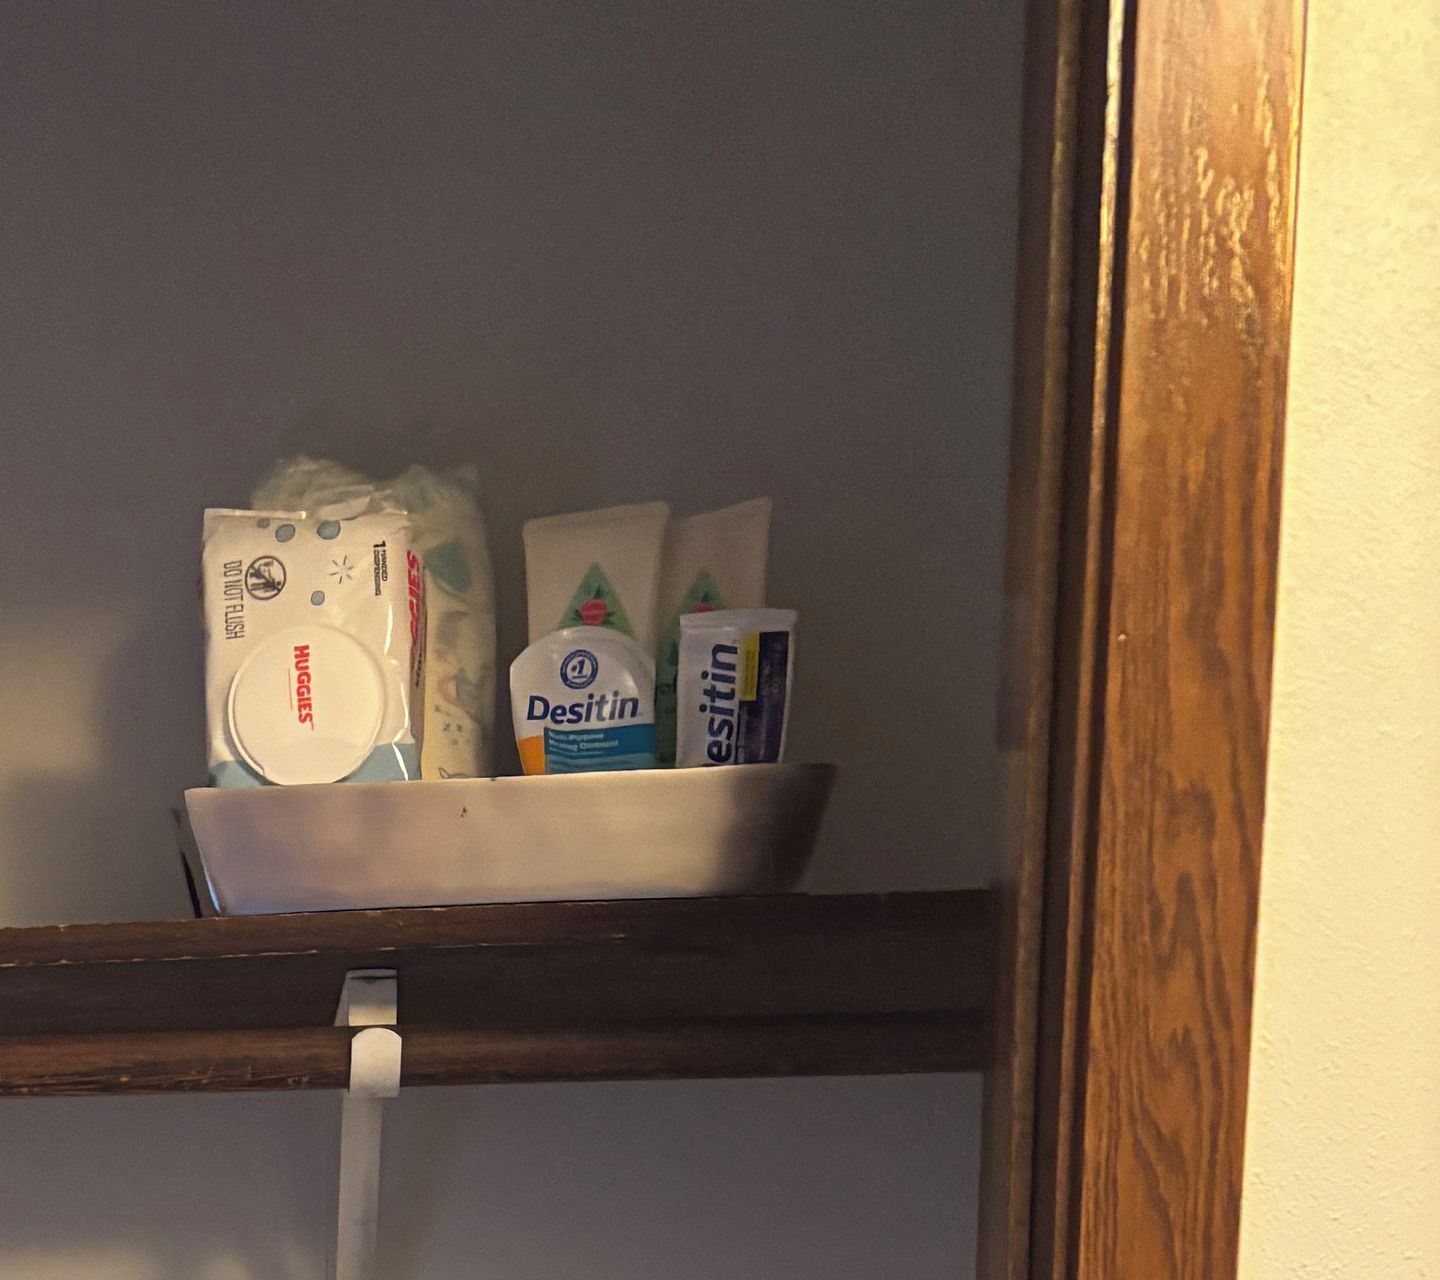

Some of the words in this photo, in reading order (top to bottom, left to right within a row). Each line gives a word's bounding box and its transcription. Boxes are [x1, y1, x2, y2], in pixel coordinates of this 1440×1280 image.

[373, 540, 387, 548] 1
[223, 559, 242, 578] DO
[224, 579, 244, 601] NOT
[225, 603, 245, 640] FLUSH
[293, 644, 313, 724] HUGGIES
[526, 690, 640, 725] Desitin
[699, 643, 738, 764] esitin
